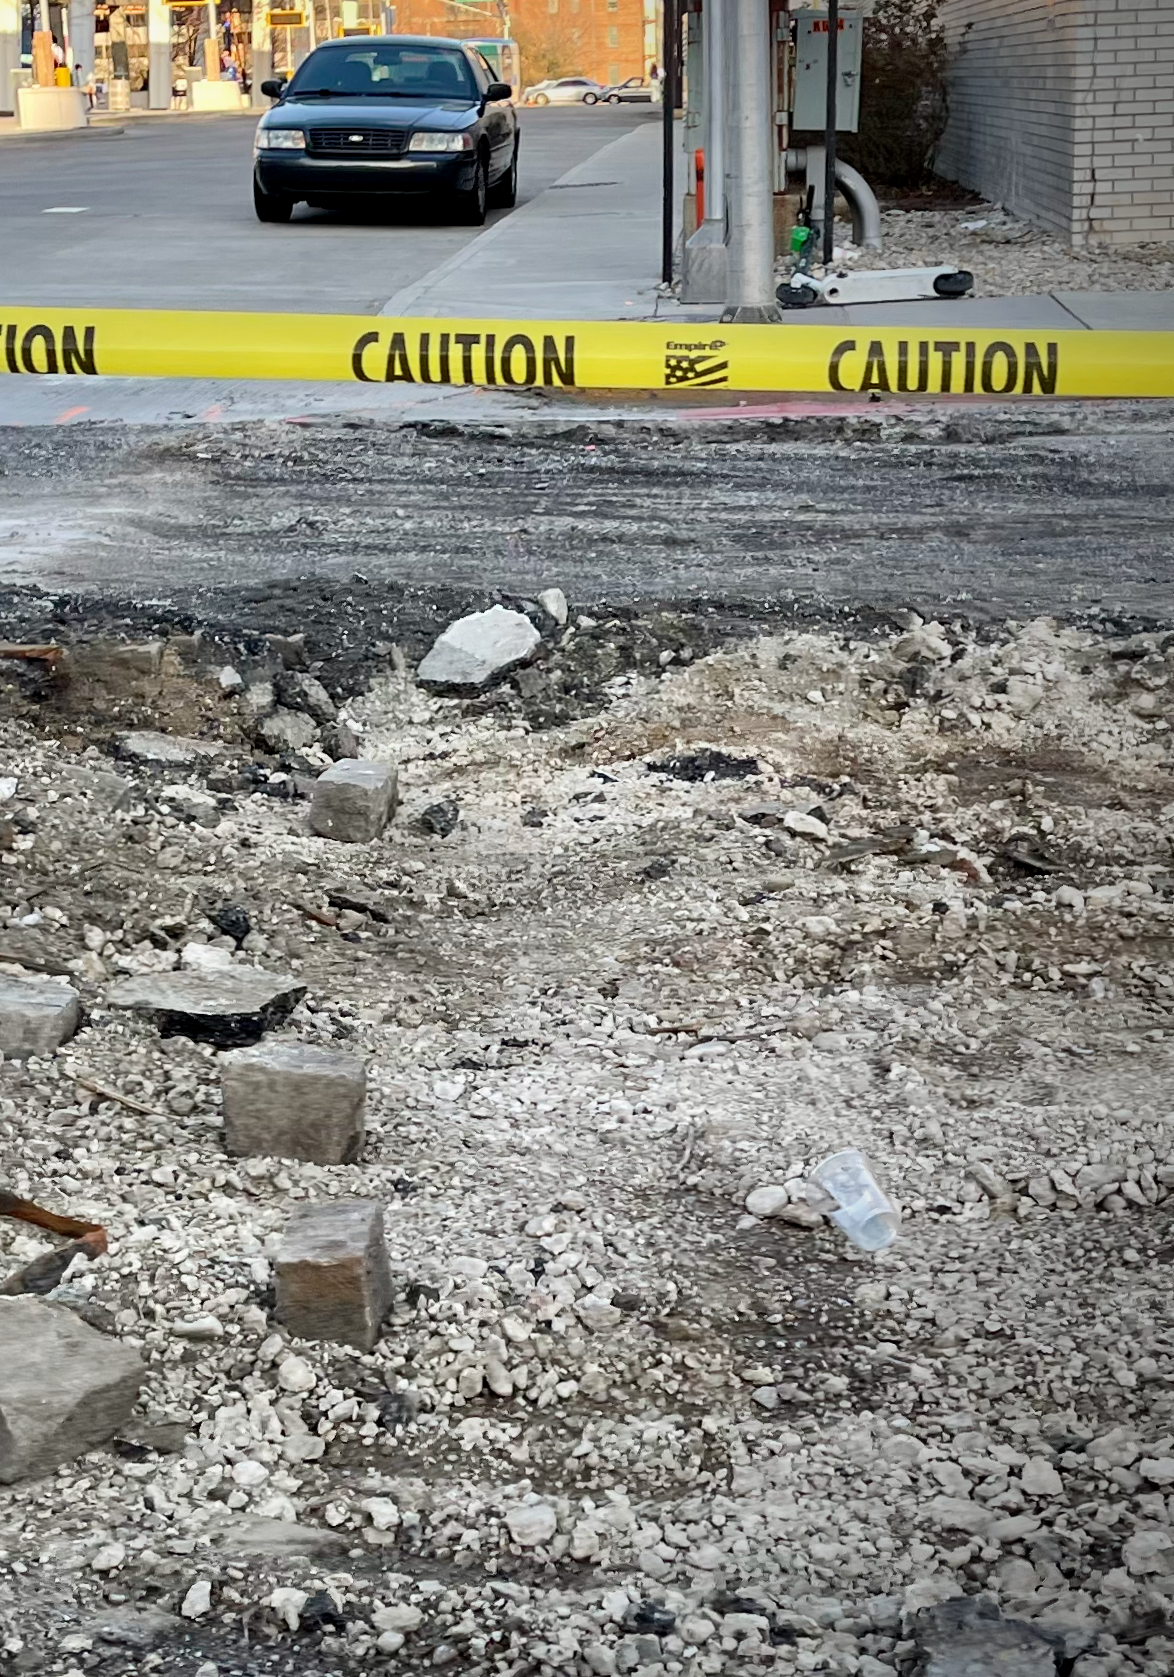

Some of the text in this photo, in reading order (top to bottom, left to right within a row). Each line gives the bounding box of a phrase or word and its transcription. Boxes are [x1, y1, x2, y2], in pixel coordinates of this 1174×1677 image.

[351, 331, 576, 386] CAUTION
[666, 340, 725, 352] Empire
[828, 340, 1058, 394] CAUTION
